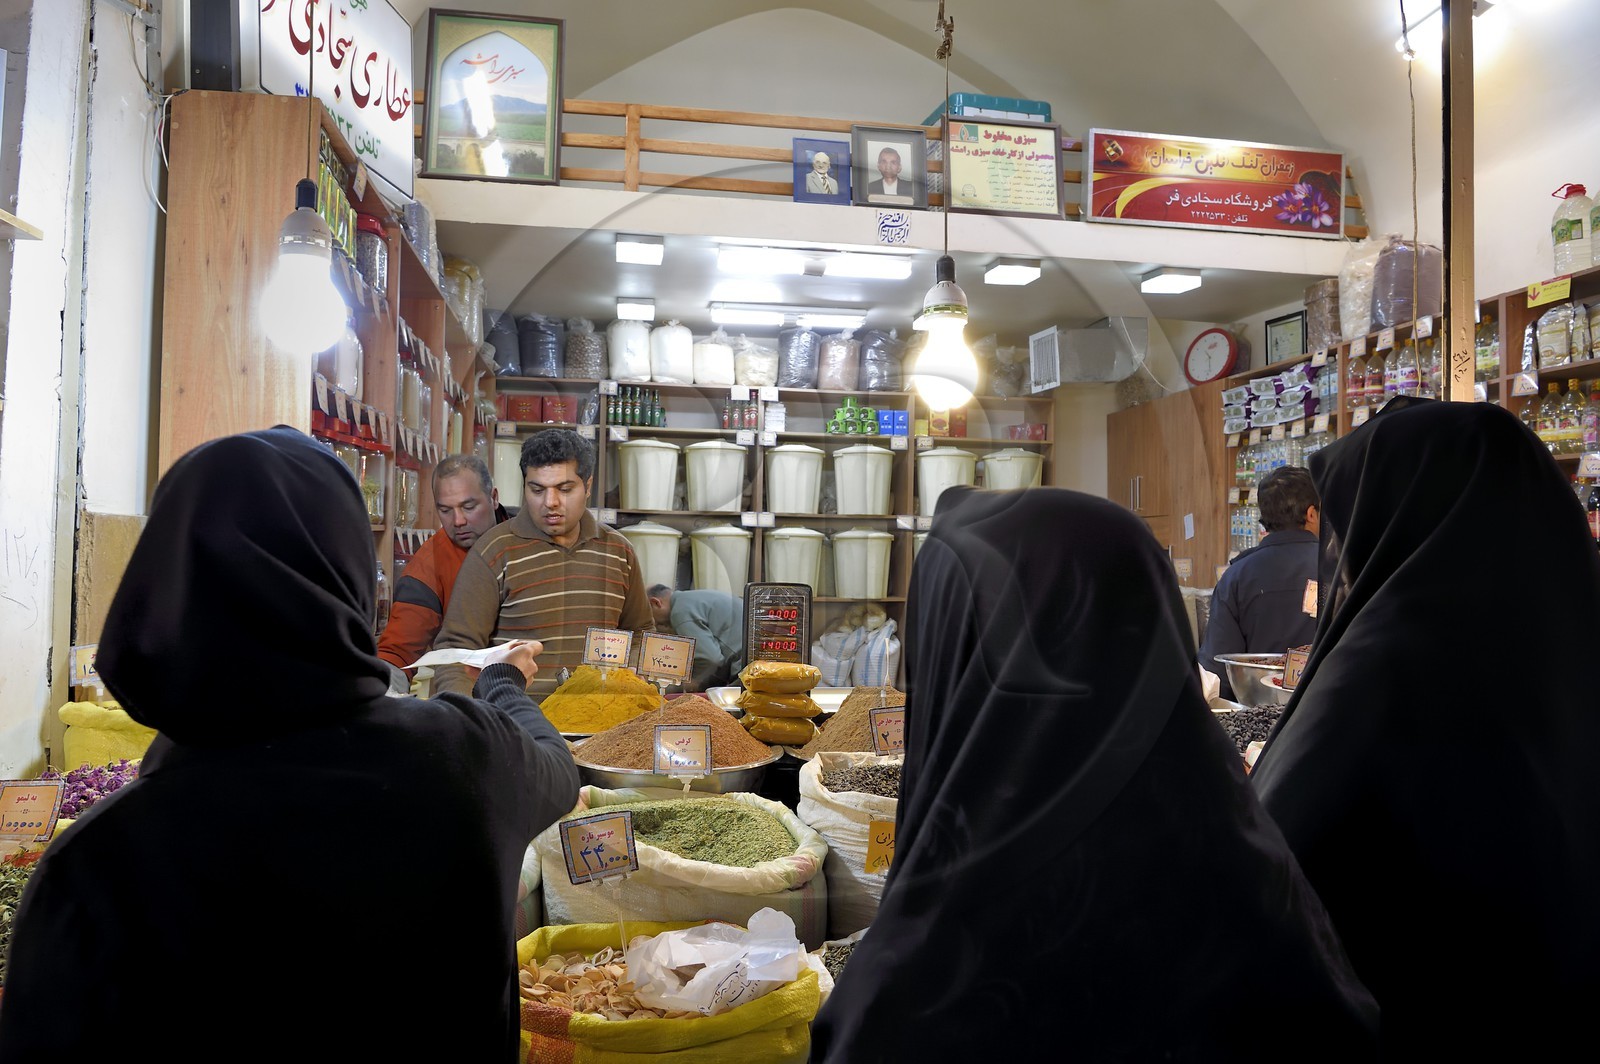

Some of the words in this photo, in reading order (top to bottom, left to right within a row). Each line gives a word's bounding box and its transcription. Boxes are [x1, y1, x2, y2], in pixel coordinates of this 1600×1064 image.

[350, 45, 411, 122] عطاری
[983, 130, 1012, 143] مخلوط
[1014, 134, 1037, 146] سبزی
[355, 131, 382, 159] تلفن
[971, 147, 991, 157] سبزی
[1025, 151, 1054, 161] محصولی
[1261, 156, 1295, 178] زعفران
[1224, 192, 1273, 212] فروشگاه
[789, 625, 797, 635] 0
[762, 641, 797, 650] 14000
[675, 736, 692, 746] کرفس
[596, 829, 615, 841] موسیر
